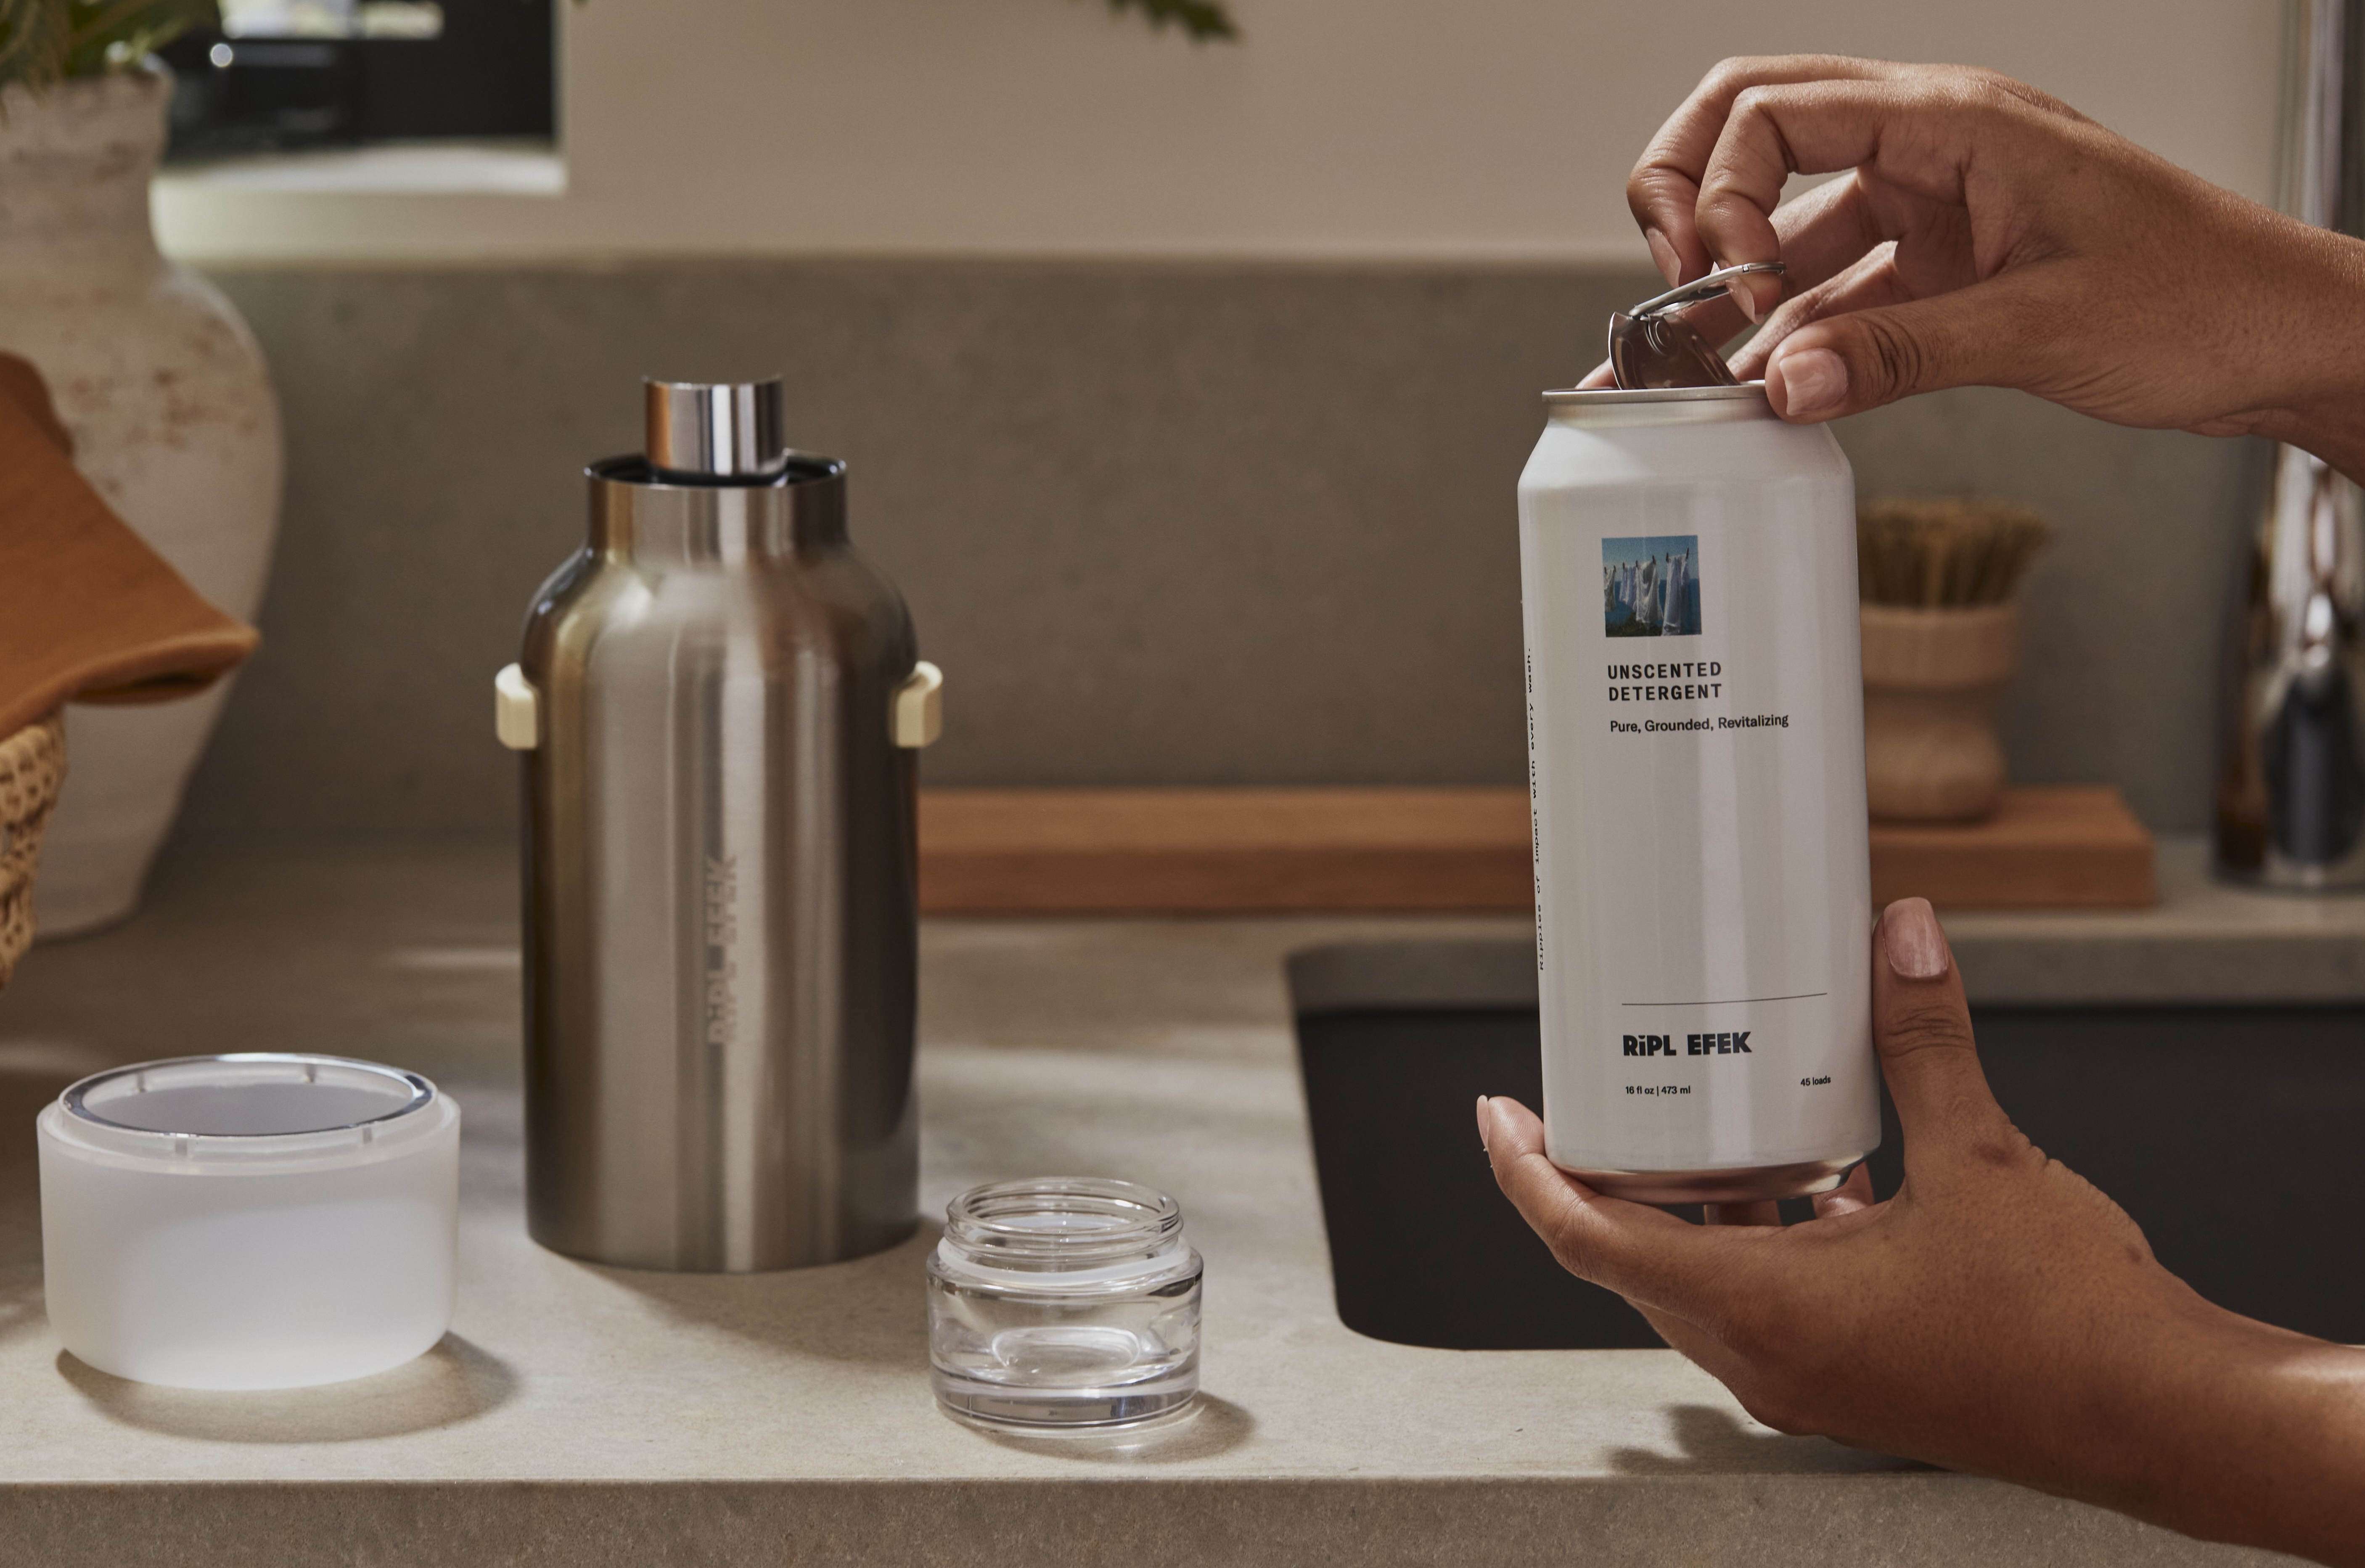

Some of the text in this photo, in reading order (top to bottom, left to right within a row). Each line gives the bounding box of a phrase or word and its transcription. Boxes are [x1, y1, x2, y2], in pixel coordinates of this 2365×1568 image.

[1608, 661, 1721, 680] UNSCENTED
[1609, 683, 1722, 701] DETERGENT
[1610, 714, 1789, 734] Pure, Grounded, Revitalizing
[1536, 875, 1540, 894] of
[705, 855, 737, 945] EFEK
[1687, 1031, 1752, 1056] EFEK
[1625, 1086, 1635, 1095] 16
[1636, 1086, 1642, 1095] fl
[1661, 1086, 1677, 1095] 473
[1680, 1085, 1691, 1094] ml
[1800, 1075, 1831, 1087] 45 loads
